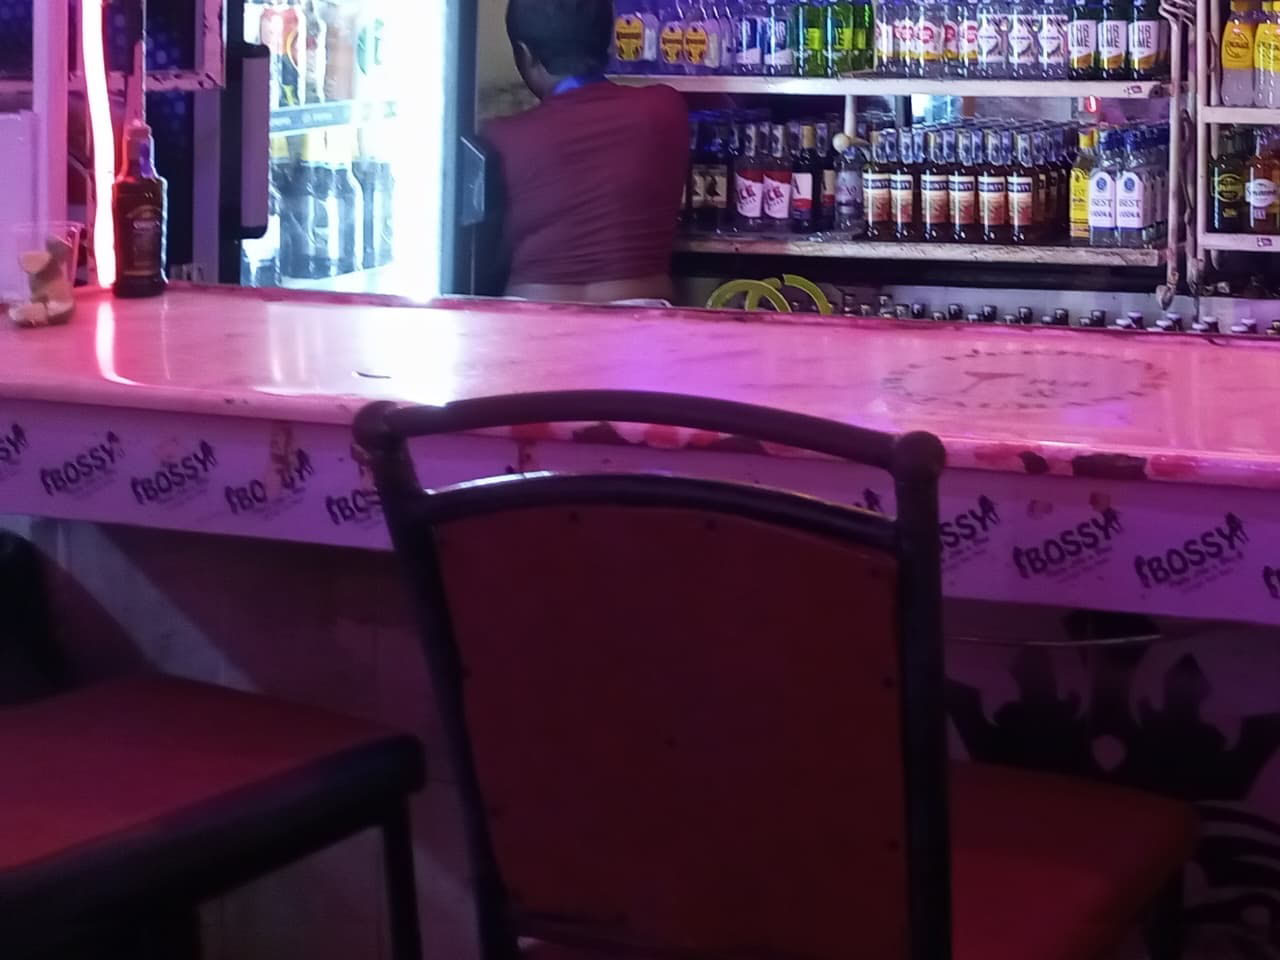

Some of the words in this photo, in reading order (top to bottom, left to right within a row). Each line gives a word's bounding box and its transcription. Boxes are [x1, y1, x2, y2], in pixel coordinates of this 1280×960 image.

[48, 433, 119, 493] BOSSY
[142, 442, 215, 502] BOSSY
[1024, 510, 1119, 575] BOSSY
[1147, 514, 1244, 585] BOSSY
